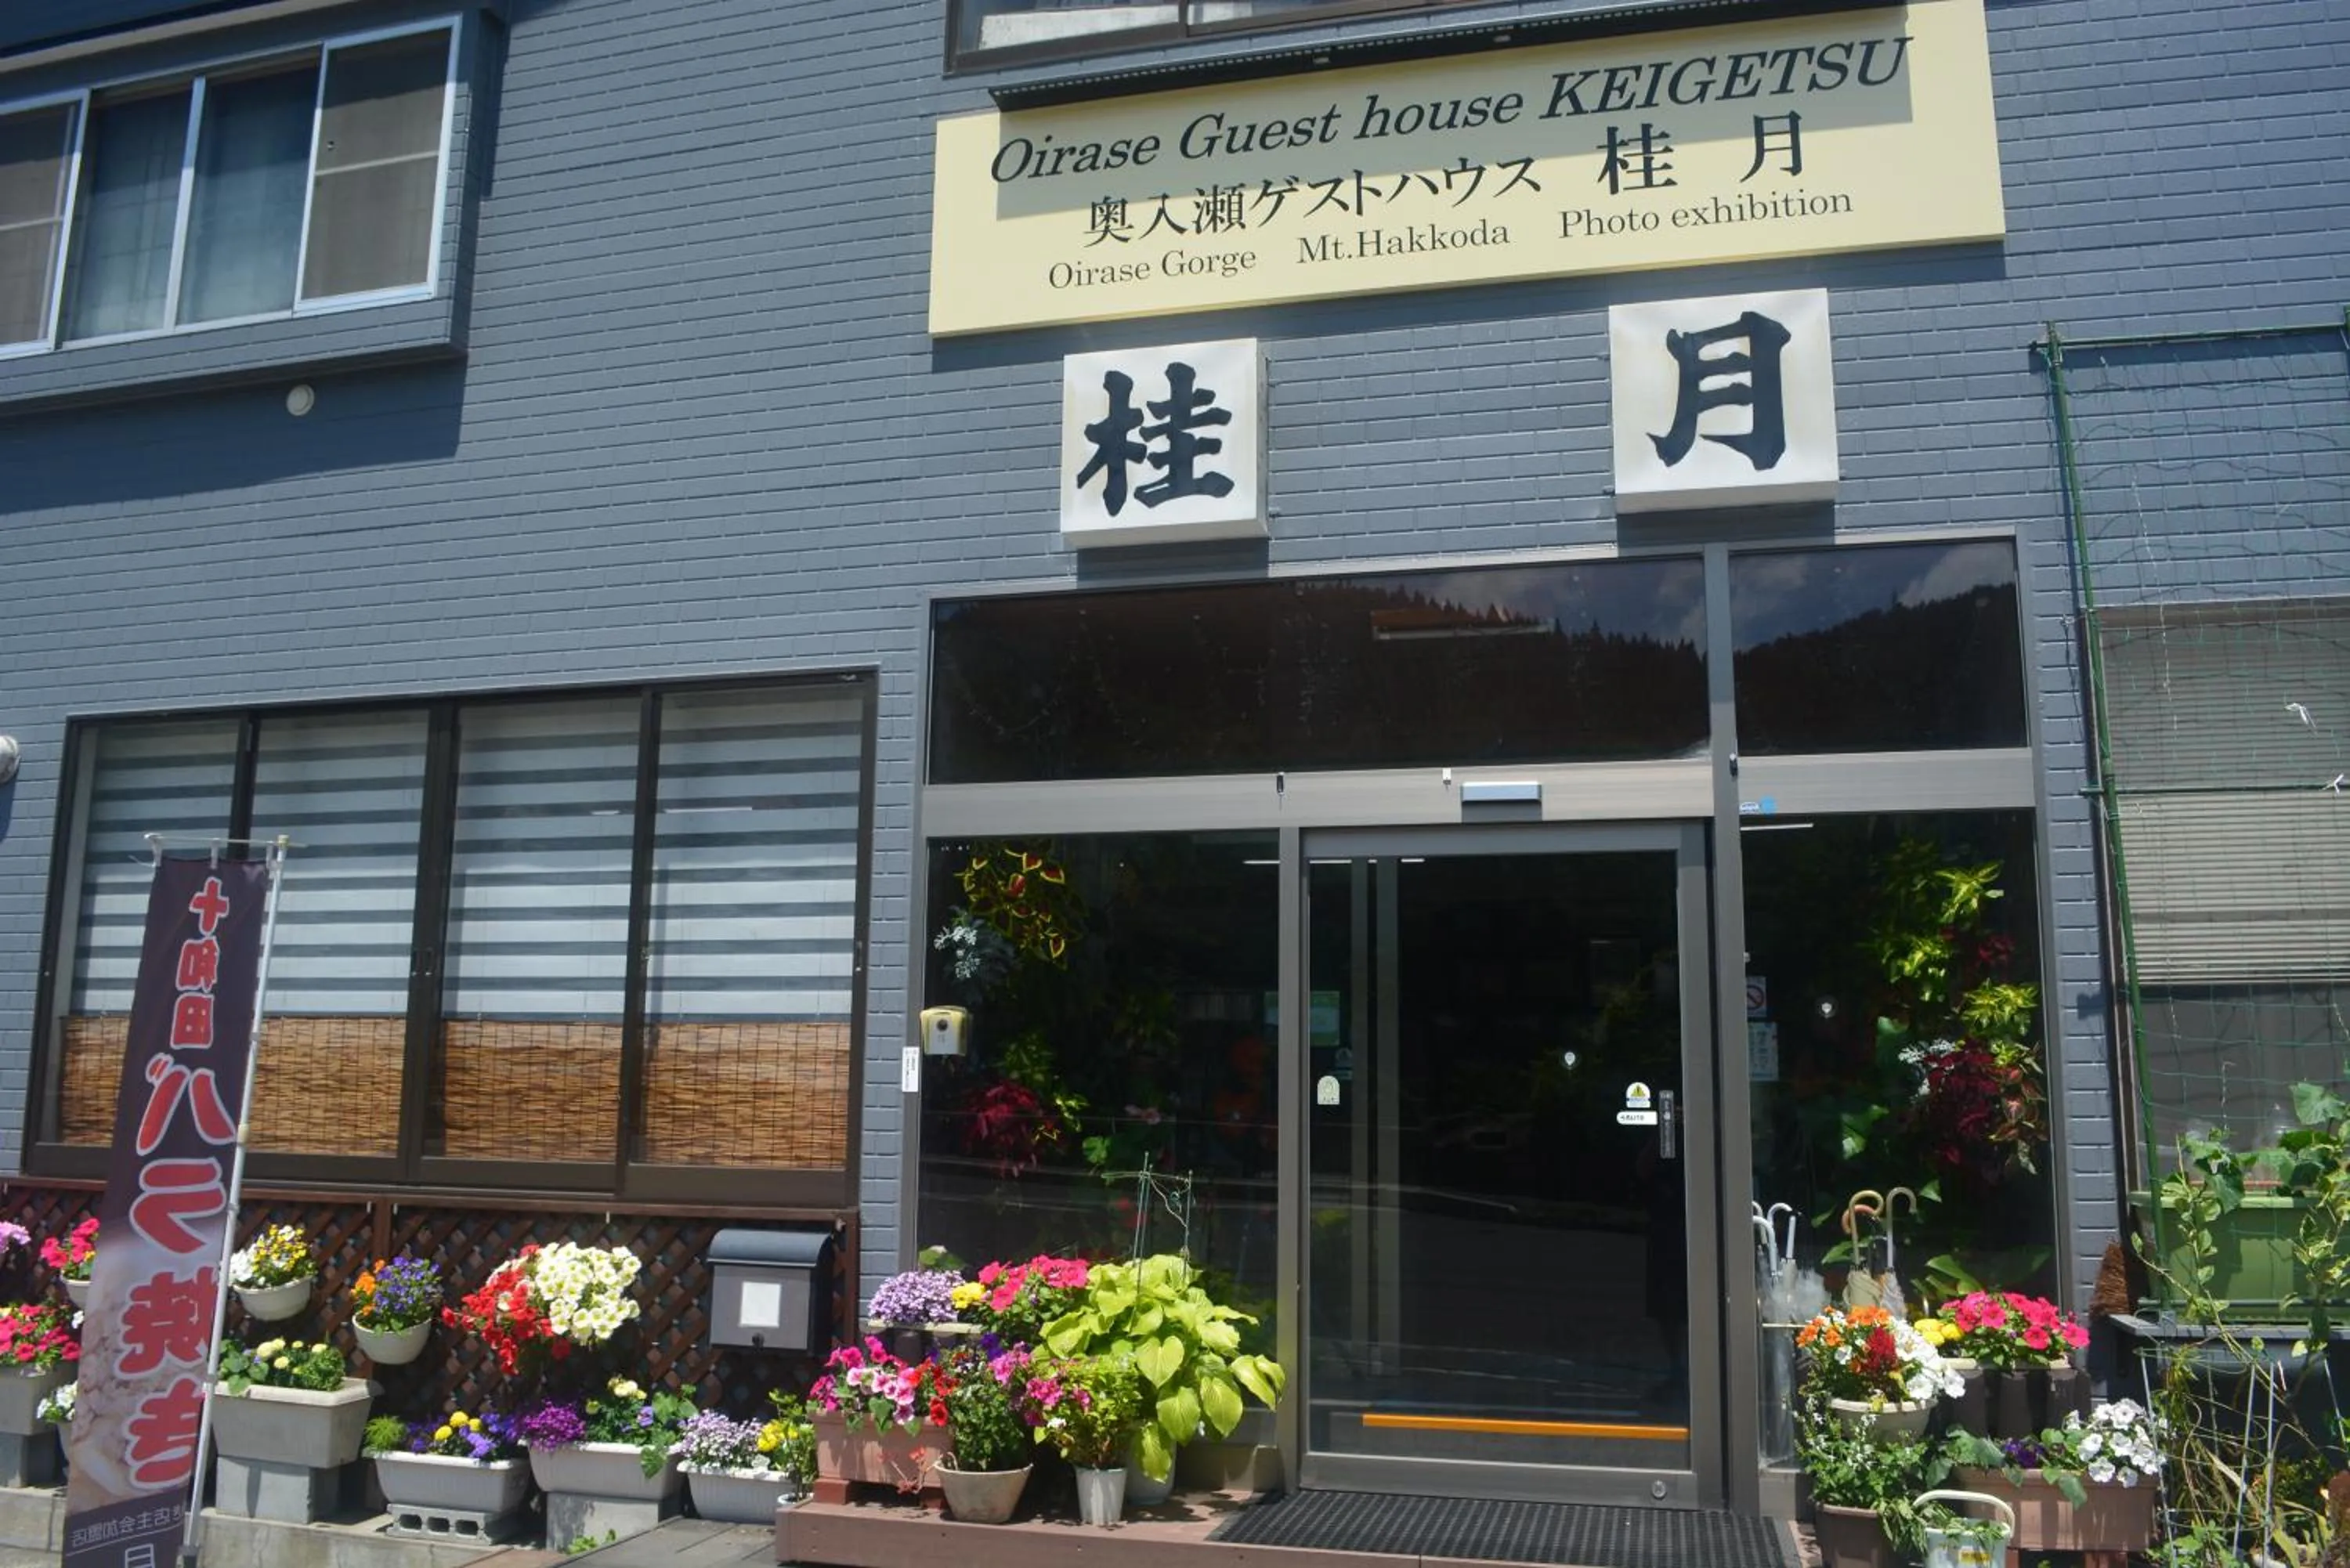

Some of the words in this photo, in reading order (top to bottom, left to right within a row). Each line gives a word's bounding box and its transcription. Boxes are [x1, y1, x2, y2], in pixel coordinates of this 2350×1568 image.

[990, 133, 1161, 183] Oirase
[1178, 103, 1340, 160] Guest
[1353, 92, 1524, 142] house
[1538, 36, 1914, 120] KEIGETSU
[1048, 255, 1151, 290] Oirase
[1161, 249, 1257, 279] Gorge
[1296, 219, 1511, 265] Mt.Hakkoda
[1558, 205, 1661, 239] Photo
[1671, 188, 1854, 229] exhibition
[1083, 156, 1542, 248] 奥入瀬ゲストハウス
[1076, 360, 1236, 517] 桂
[1645, 311, 1791, 471] 月
